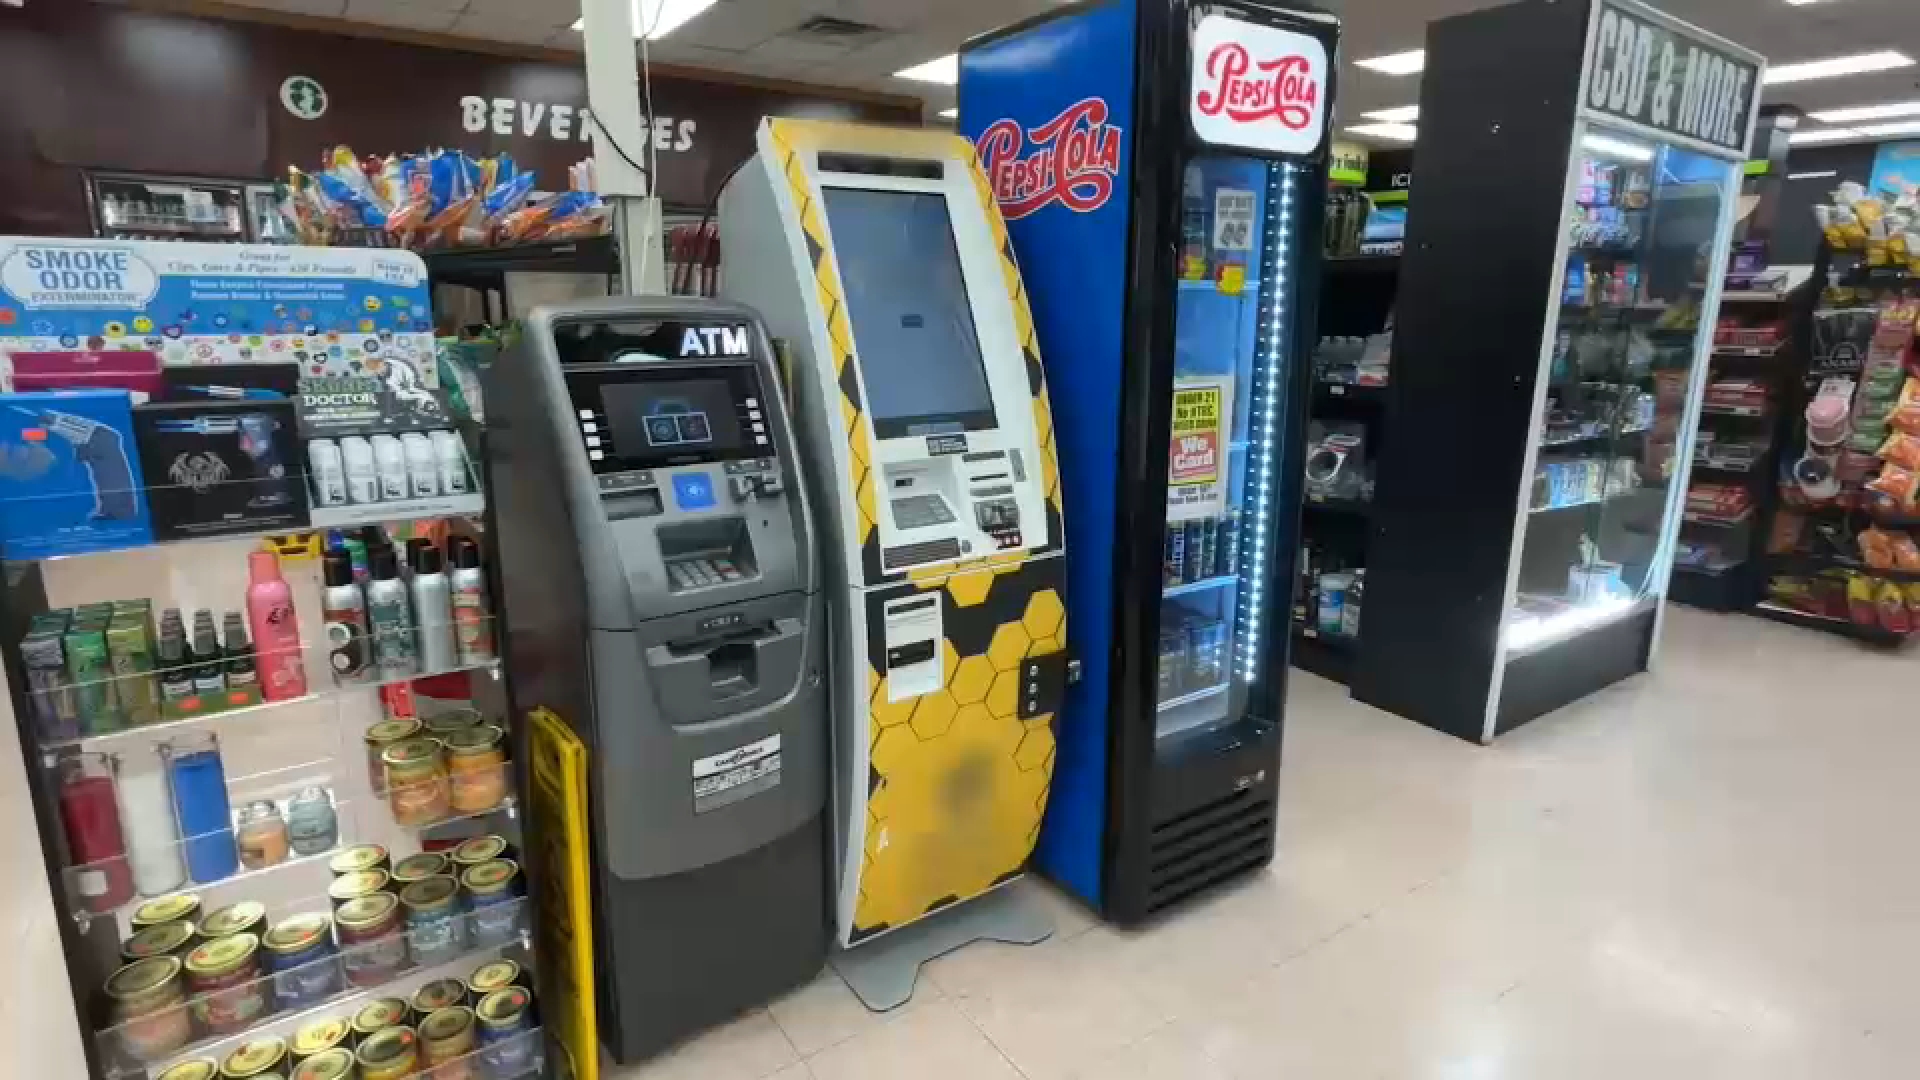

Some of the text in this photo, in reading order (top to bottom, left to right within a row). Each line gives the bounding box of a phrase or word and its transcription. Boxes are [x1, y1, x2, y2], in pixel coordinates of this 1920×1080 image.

[1591, 10, 1748, 145] CBD & MORE
[459, 95, 697, 152] BEVERES
[25, 249, 128, 271] SMOKE
[39, 270, 124, 290] ODOR
[679, 325, 749, 357] ATM
[302, 392, 379, 407] DOCTOR
